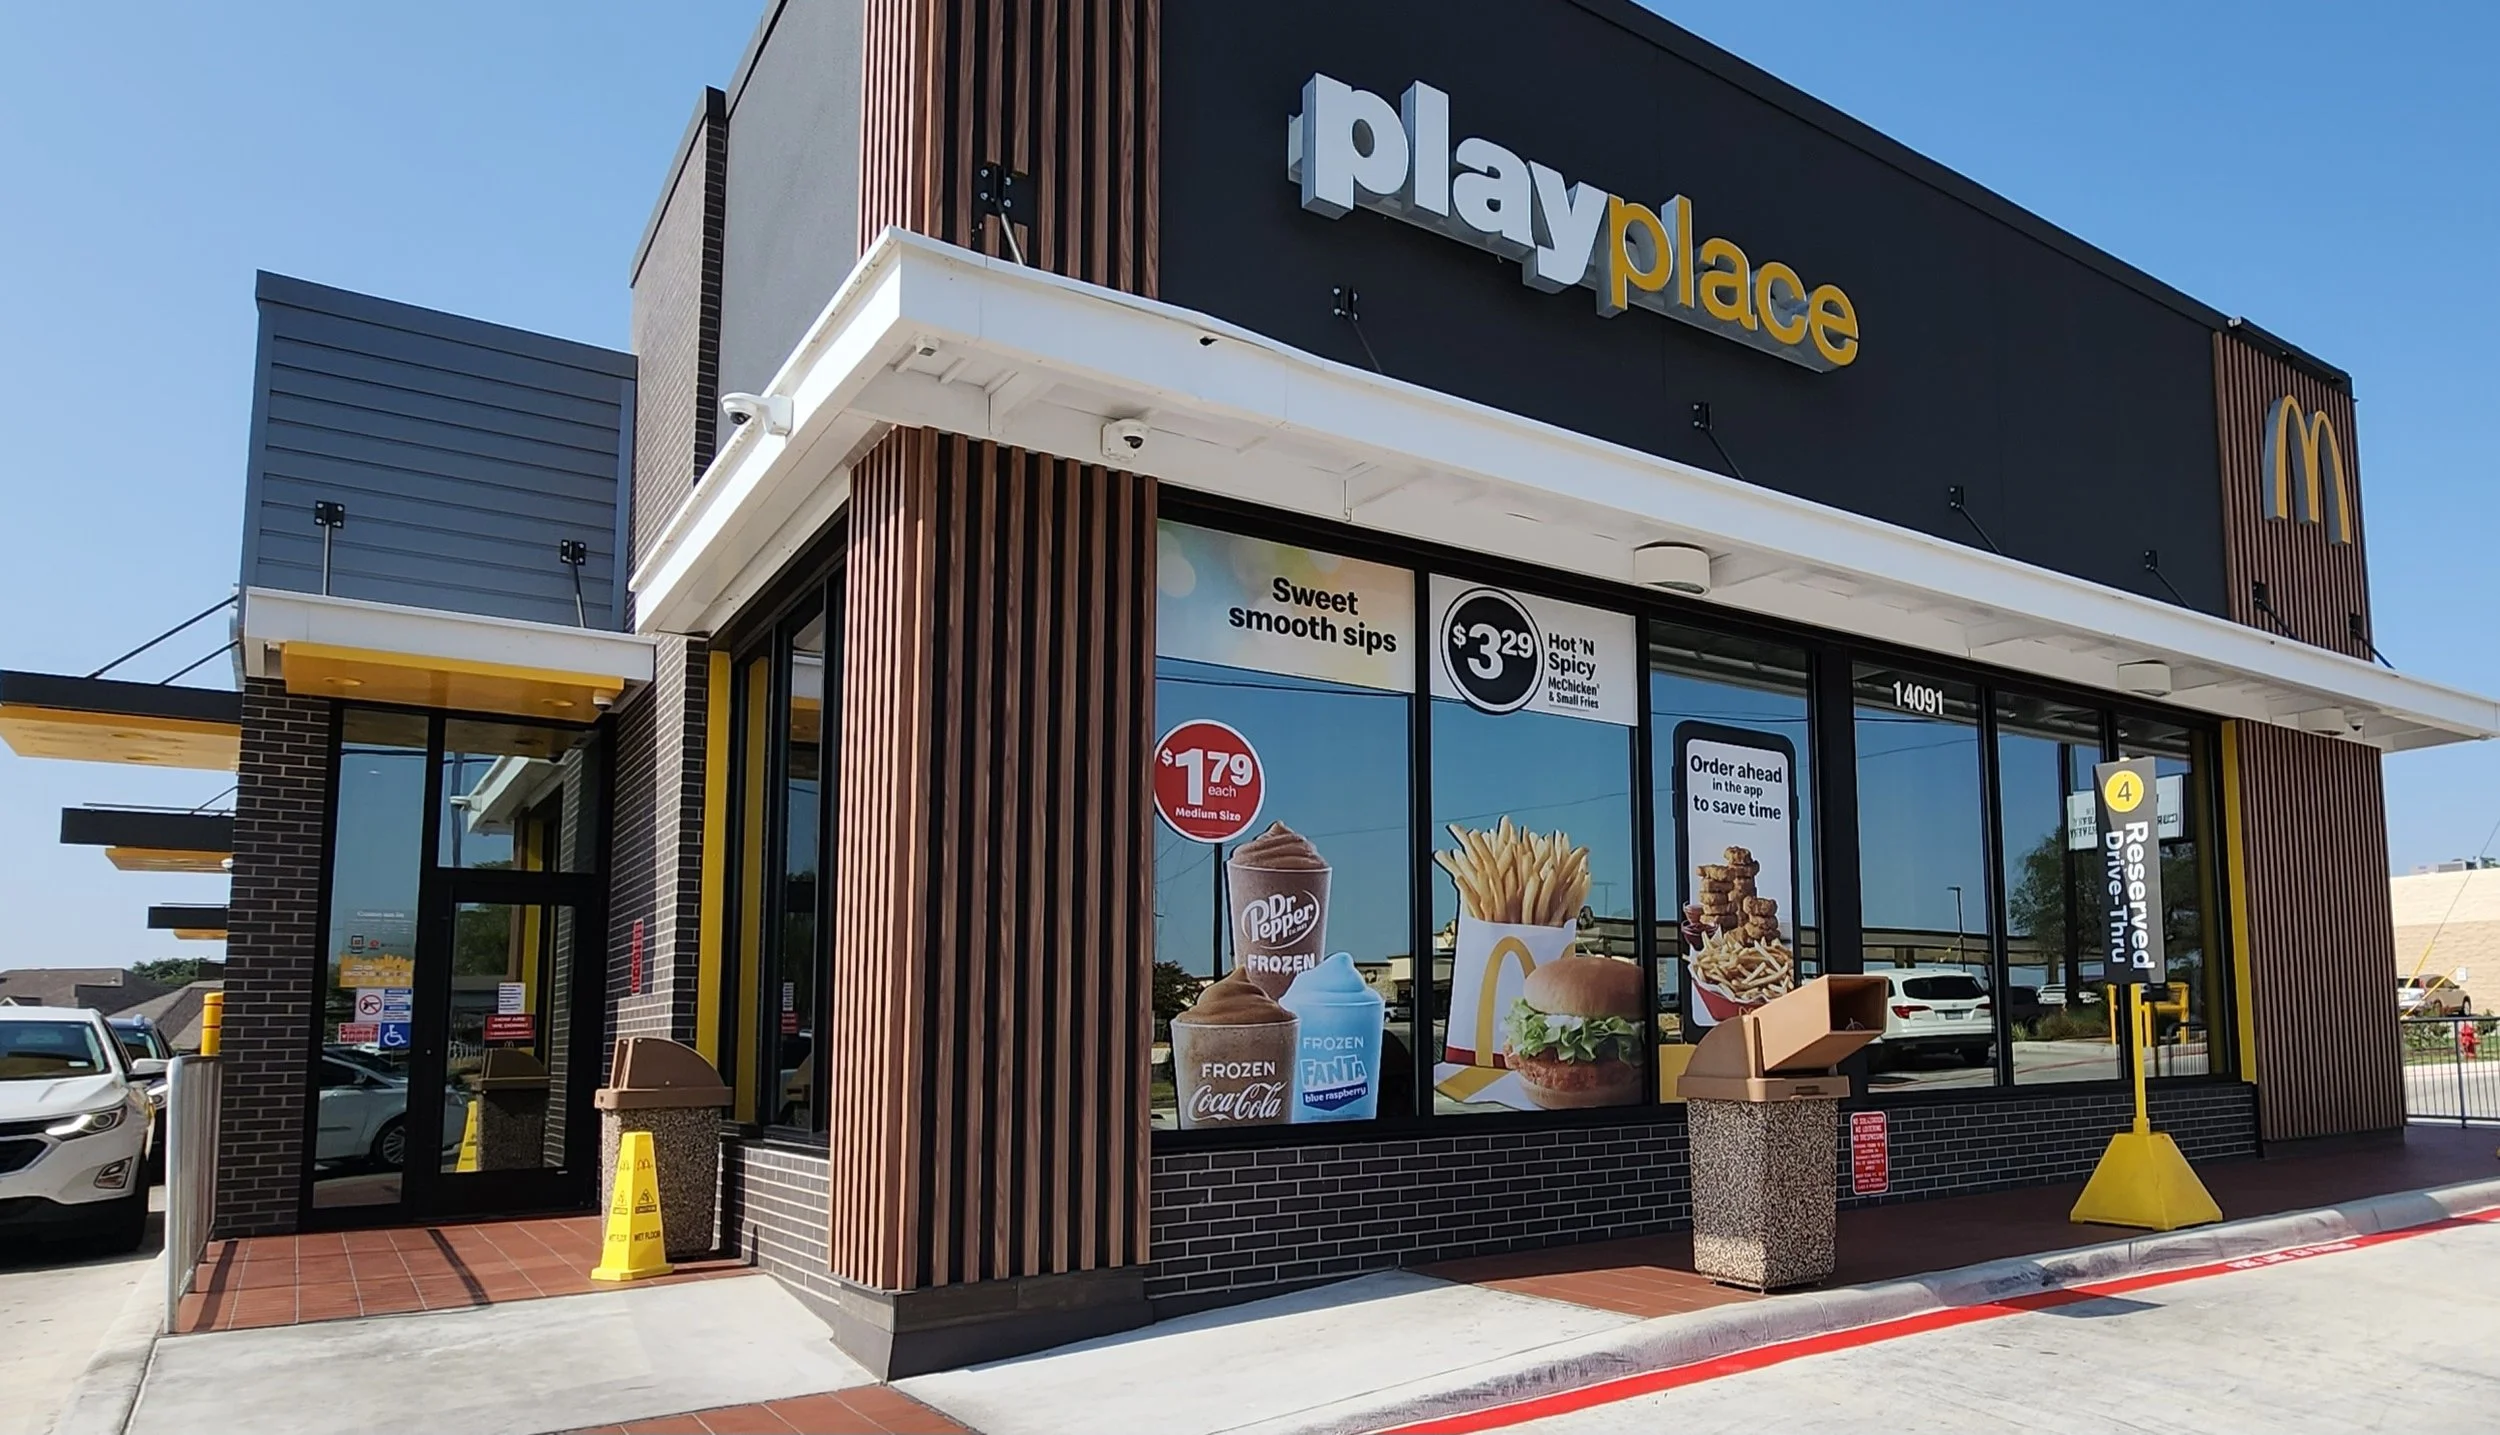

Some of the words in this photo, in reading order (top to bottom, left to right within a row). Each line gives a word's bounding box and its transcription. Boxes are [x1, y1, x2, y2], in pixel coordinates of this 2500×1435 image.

[1273, 577, 1358, 615] Sweet
[1229, 606, 1337, 642] smooth
[1343, 622, 1397, 655] sips
[1548, 633, 1576, 651] Hot
[1548, 652, 1596, 681] Spicy
[1549, 691, 1555, 702] &
[1556, 692, 1579, 706] Small
[1580, 695, 1599, 709] Fries
[1893, 681, 1943, 715] 14091
[1690, 754, 1735, 778] Order
[1737, 761, 1782, 784] ahead
[1208, 785, 1237, 798] each
[1712, 778, 1723, 791] in
[1724, 779, 1742, 794] the
[1743, 784, 1763, 798] app
[2117, 780, 2132, 802] 4
[1175, 807, 1218, 820] Medium
[1219, 810, 1241, 822] Size
[1693, 794, 1710, 812] to
[1712, 800, 1746, 818] save
[1748, 800, 1782, 820] time
[1268, 894, 1297, 920] Dr
[2105, 830, 2129, 963] Drive-Thru
[2125, 821, 2156, 969] Reserved
[1241, 899, 1314, 943] Pepper
[1247, 953, 1315, 976] FROZEN
[1303, 1036, 1364, 1050] FROZEN
[1202, 1061, 1276, 1078] FROZEN
[1300, 1054, 1367, 1088] FANTA
[1305, 1094, 1324, 1103] blue
[1326, 1087, 1366, 1100] raspberry
